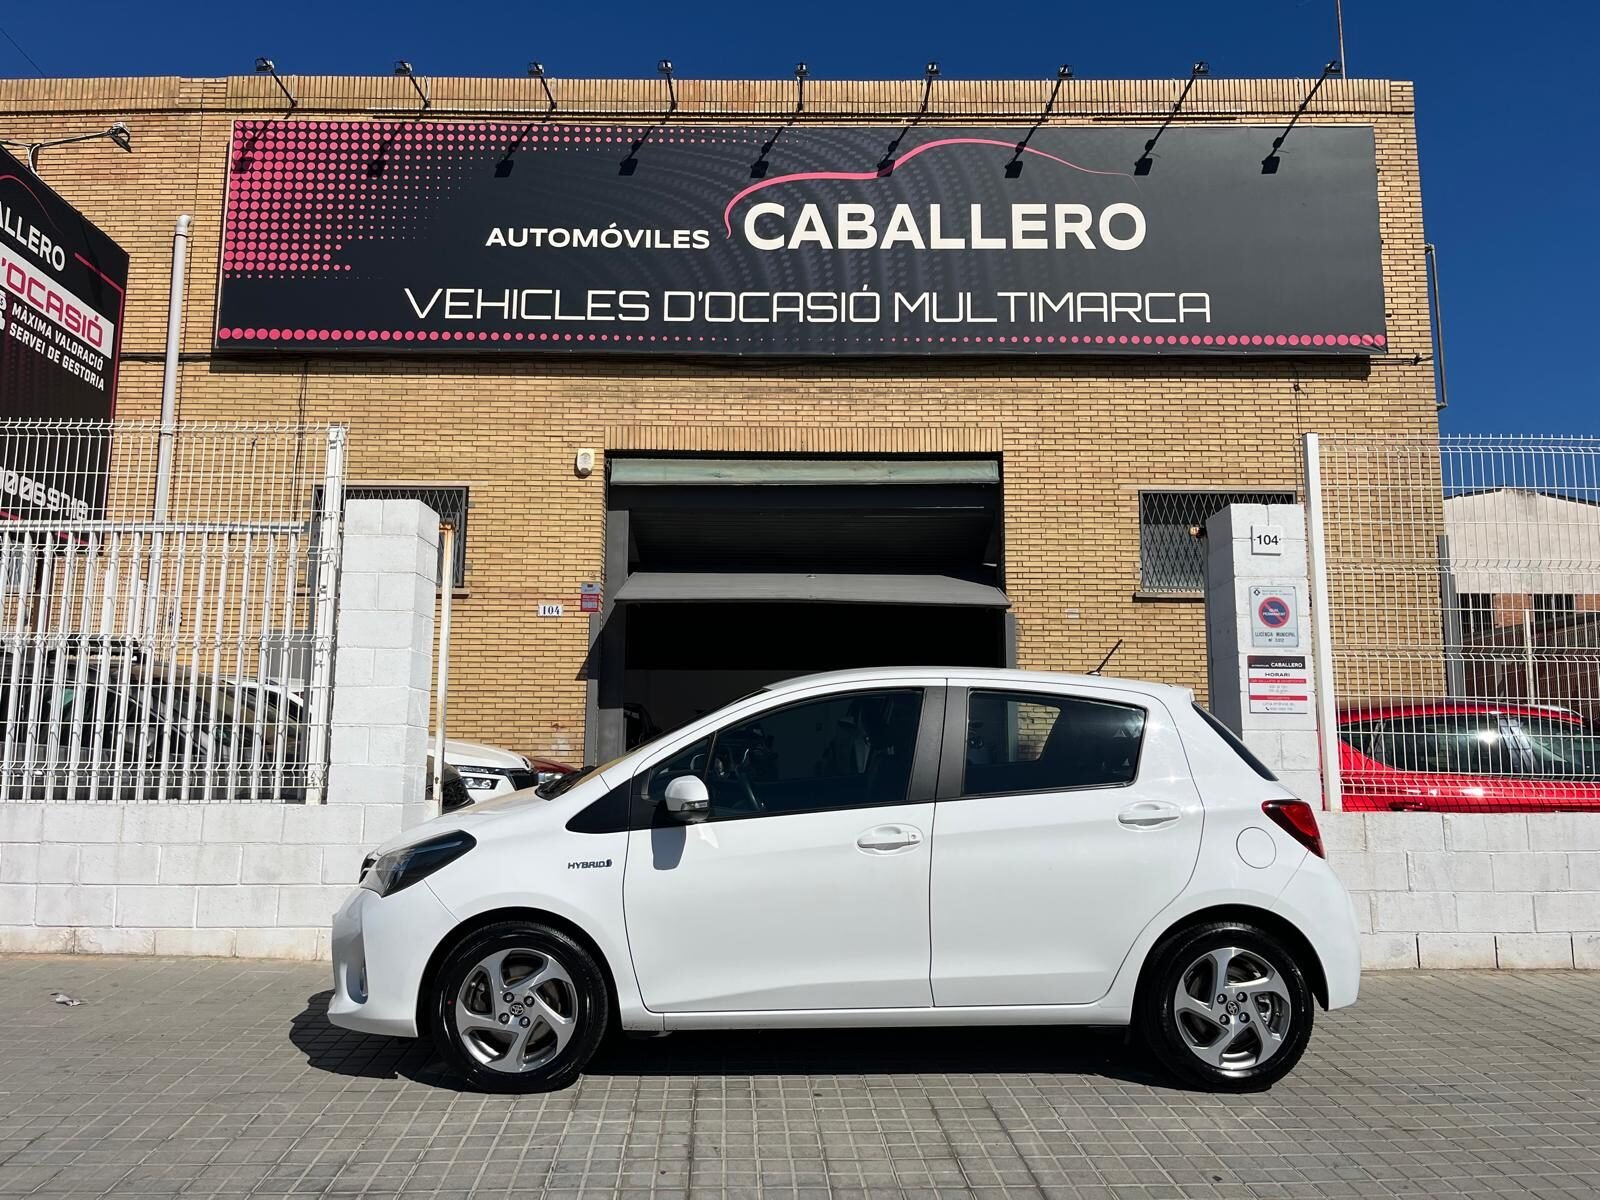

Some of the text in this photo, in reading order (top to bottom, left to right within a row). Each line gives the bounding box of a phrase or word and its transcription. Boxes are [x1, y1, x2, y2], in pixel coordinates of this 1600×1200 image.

[0, 201, 66, 272] LLERO
[485, 202, 1147, 251] AUTOMÓVILES CABALLERO
[404, 287, 651, 322] VEHICLES
[663, 283, 881, 324] D'OCASIÓ
[9, 322, 105, 392] SERVEI DE GESTORIA
[12, 302, 104, 372] MÀXIMA VALORACIÓ
[0, 466, 89, 521] 0069718
[1256, 534, 1279, 546] 104
[542, 605, 560, 615] 104
[567, 860, 606, 870] HYBRID
